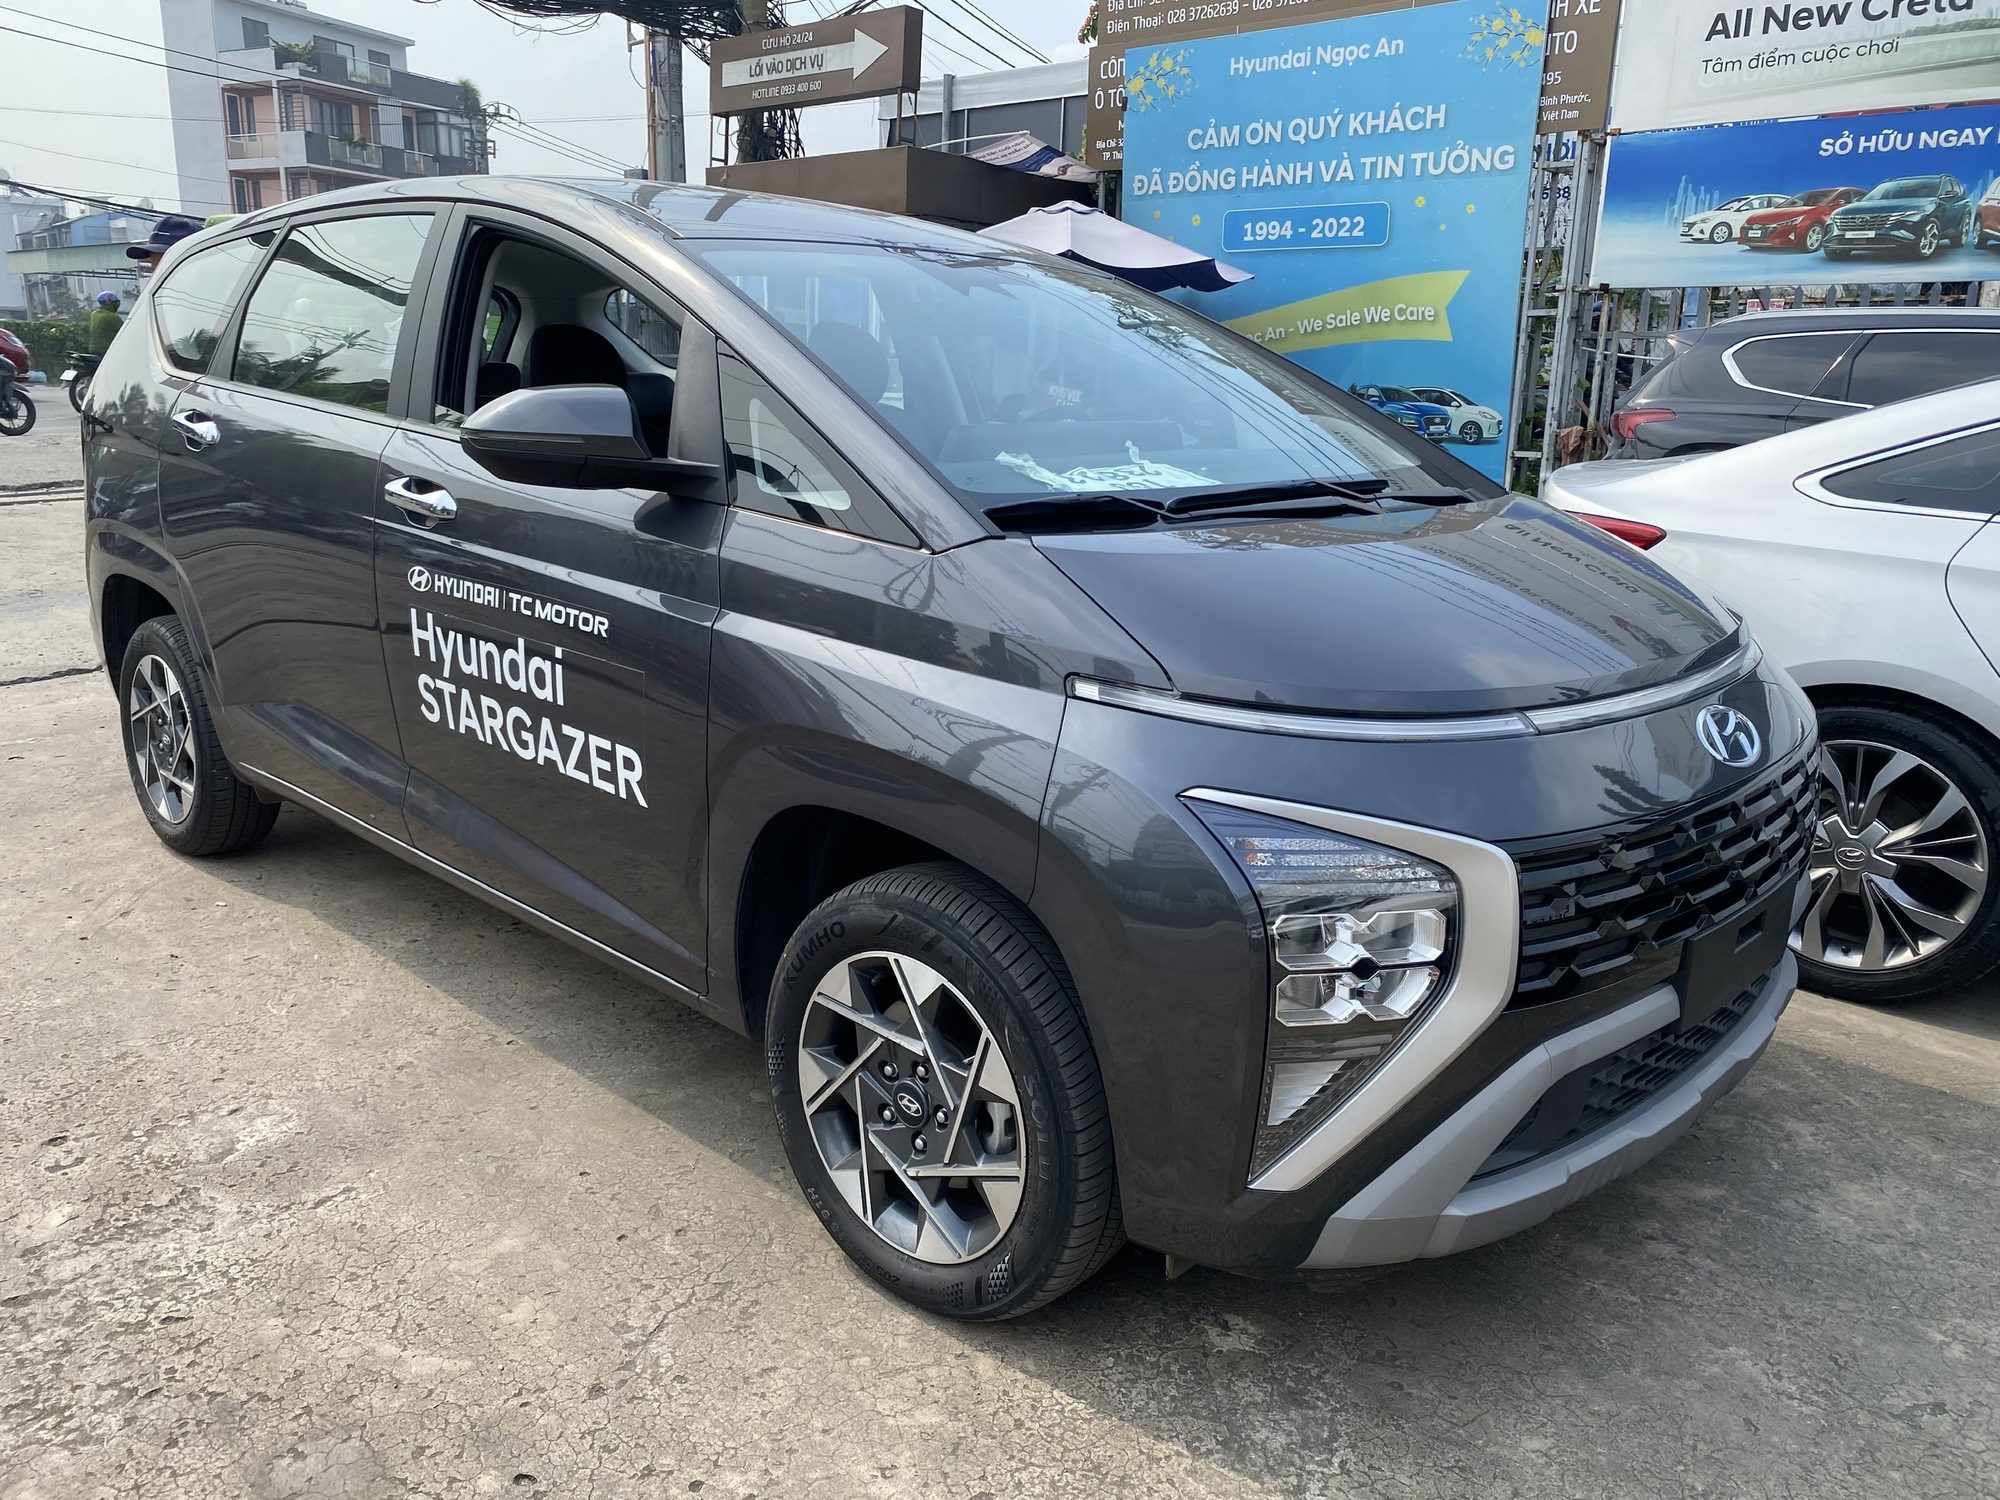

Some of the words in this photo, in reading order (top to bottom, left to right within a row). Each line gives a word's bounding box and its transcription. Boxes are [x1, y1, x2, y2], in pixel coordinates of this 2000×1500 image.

[1106, 20, 1130, 35] Điện
[1133, 15, 1164, 31] Thoại:
[1167, 8, 1186, 25] 028
[1188, 2, 1239, 21] 37262639
[1704, 8, 1753, 42] All
[1762, 1, 1851, 35] New
[762, 35, 778, 50] CỨU
[780, 34, 790, 49] HỘ
[792, 31, 813, 46] 24/24
[1229, 51, 1312, 79] Hyundai
[1316, 42, 1370, 70] Ngọc
[1374, 37, 1405, 57] An
[1702, 57, 1742, 75] Tâm
[1748, 47, 1795, 70] điểm
[1801, 44, 1850, 63] cuộc
[1857, 37, 1900, 57] chơi
[749, 58, 763, 78] LỐI
[766, 57, 783, 76] VÀO
[785, 55, 807, 75] DỊCH
[809, 54, 824, 72] VỤ
[752, 86, 779, 100] HOTLINE
[780, 84, 795, 96] 0933
[797, 82, 809, 93] 400
[809, 81, 822, 91] 600
[1095, 87, 1104, 110] Ô
[1560, 91, 1591, 104] Phước,
[1187, 119, 1240, 151] CẢM
[1245, 114, 1283, 145] ƠN
[1287, 107, 1343, 144] QUÝ
[1349, 103, 1447, 138] KHÁCH
[1542, 111, 1558, 123] Việt
[1561, 109, 1579, 119] Nam
[1818, 131, 1853, 157] SỞ
[1858, 128, 1913, 154] HỮU
[1918, 126, 1993, 150] NGAY
[1133, 167, 1164, 196] ĐÃ
[1168, 160, 1236, 193] ĐỒNG
[1241, 158, 1314, 189] HÀNH
[1318, 153, 1354, 184] VÀ
[1360, 154, 1408, 180] TIN
[1411, 139, 1515, 178] TƯỞNG
[1243, 221, 1293, 242] 1994
[1311, 216, 1365, 239] 2022
[1265, 325, 1285, 341] An
[1298, 318, 1323, 334] We
[1326, 310, 1361, 330] Sale
[1364, 306, 1390, 324] We
[1394, 303, 1435, 322] Care
[434, 574, 499, 608] HYUNDAI
[509, 593, 532, 616] TC
[535, 602, 609, 637] MOTOR
[410, 607, 564, 706] Hyundai
[418, 674, 649, 808] STARGAZER
[782, 921, 845, 989] KUMHO
